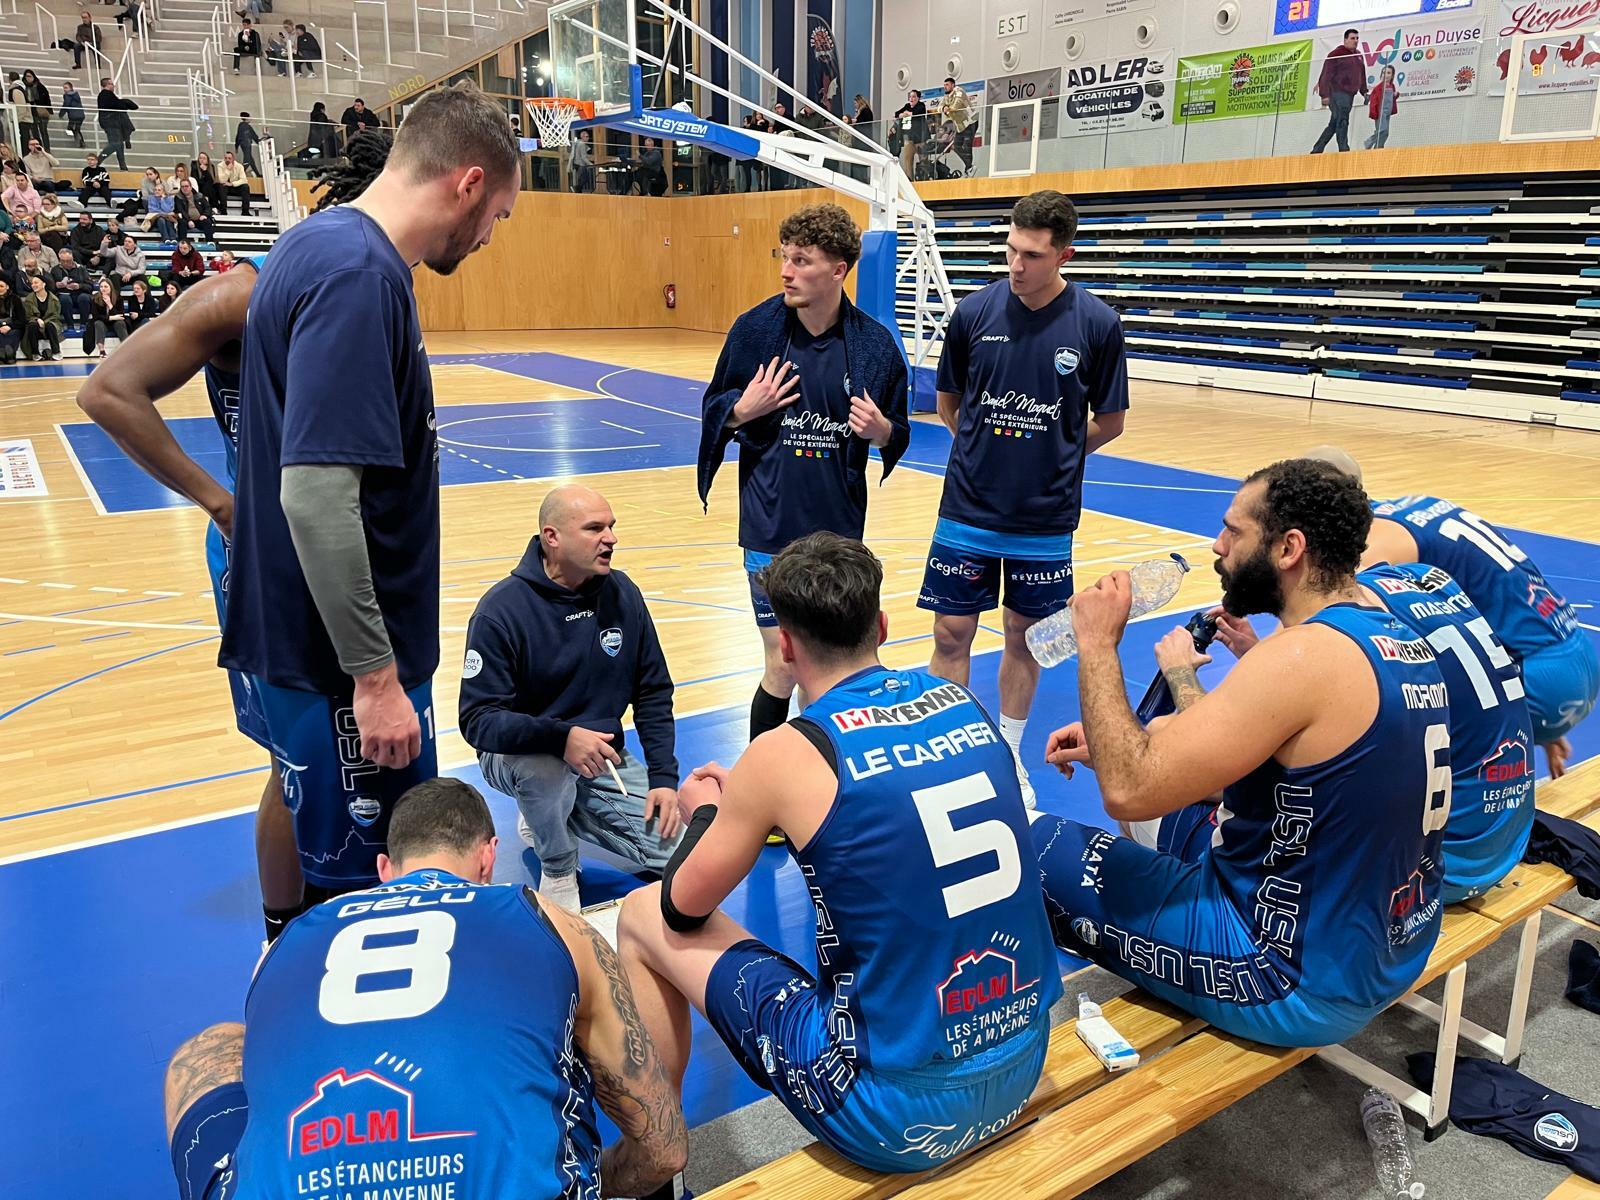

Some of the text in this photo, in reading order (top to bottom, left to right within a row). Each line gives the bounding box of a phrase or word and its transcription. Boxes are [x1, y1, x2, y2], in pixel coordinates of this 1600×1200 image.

[1288, 0, 1311, 20] 21
[998, 15, 1026, 35] EST
[1405, 28, 1481, 48] Van Duyse
[1067, 57, 1148, 88] ADLER
[388, 74, 426, 99] NORD
[1008, 80, 1036, 99] biro
[1071, 87, 1138, 102] LOCATION DE
[1228, 84, 1270, 97] SUPPORTER
[1076, 100, 1131, 114] VÉHICULES
[1226, 100, 1270, 111] MOTIVATION
[981, 391, 1063, 420] Daniel Moquet
[1000, 413, 1042, 424] SPÉCIALISTE
[1008, 421, 1048, 432] EXTÉRIEURS
[565, 611, 587, 622] CRAFT
[1425, 616, 1526, 710] 15
[835, 685, 968, 730] MAYENNE
[845, 721, 998, 781] LE CARRER
[1424, 723, 1452, 836] 6
[1483, 789, 1501, 801] LES
[1484, 802, 1497, 813] DE
[911, 771, 1022, 918] 5
[337, 891, 476, 918] GÉLU
[318, 910, 457, 1025] 8
[946, 1022, 971, 1042] LES
[953, 1039, 967, 1058] DE
[300, 1108, 398, 1156] EDLM
[298, 1153, 464, 1194] LES ÉTANCHEURS
